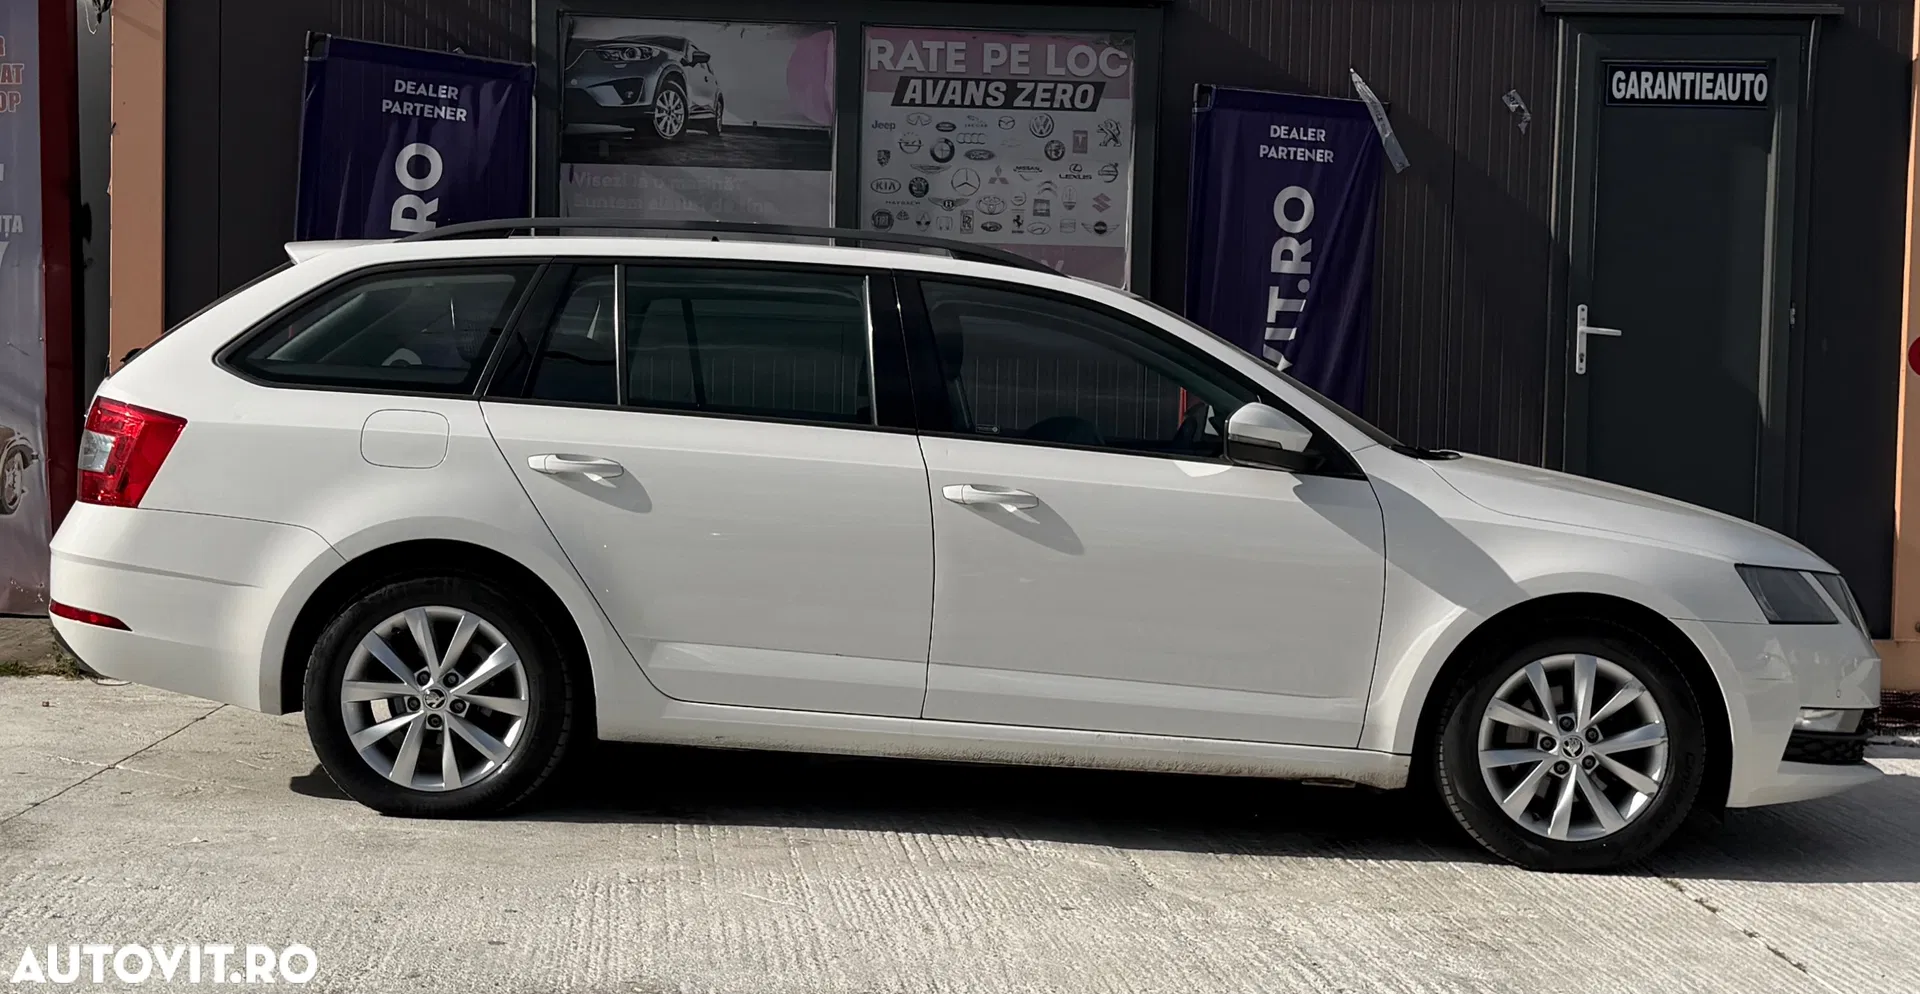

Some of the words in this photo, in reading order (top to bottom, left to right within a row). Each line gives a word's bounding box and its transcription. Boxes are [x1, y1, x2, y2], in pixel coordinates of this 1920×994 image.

[869, 38, 966, 73] RATE
[983, 43, 1031, 75] PE
[1046, 44, 1128, 78] LOC
[394, 79, 459, 100] DEALER
[902, 79, 1005, 107] AVANS
[1013, 82, 1095, 110] ZERO
[1612, 71, 1768, 102] GARANTIEAUTO
[381, 99, 467, 122] PARTENER
[871, 119, 896, 131] Jeep
[1270, 125, 1326, 142] DEALER
[1259, 145, 1334, 163] PARTENER
[875, 181, 896, 191] KIA
